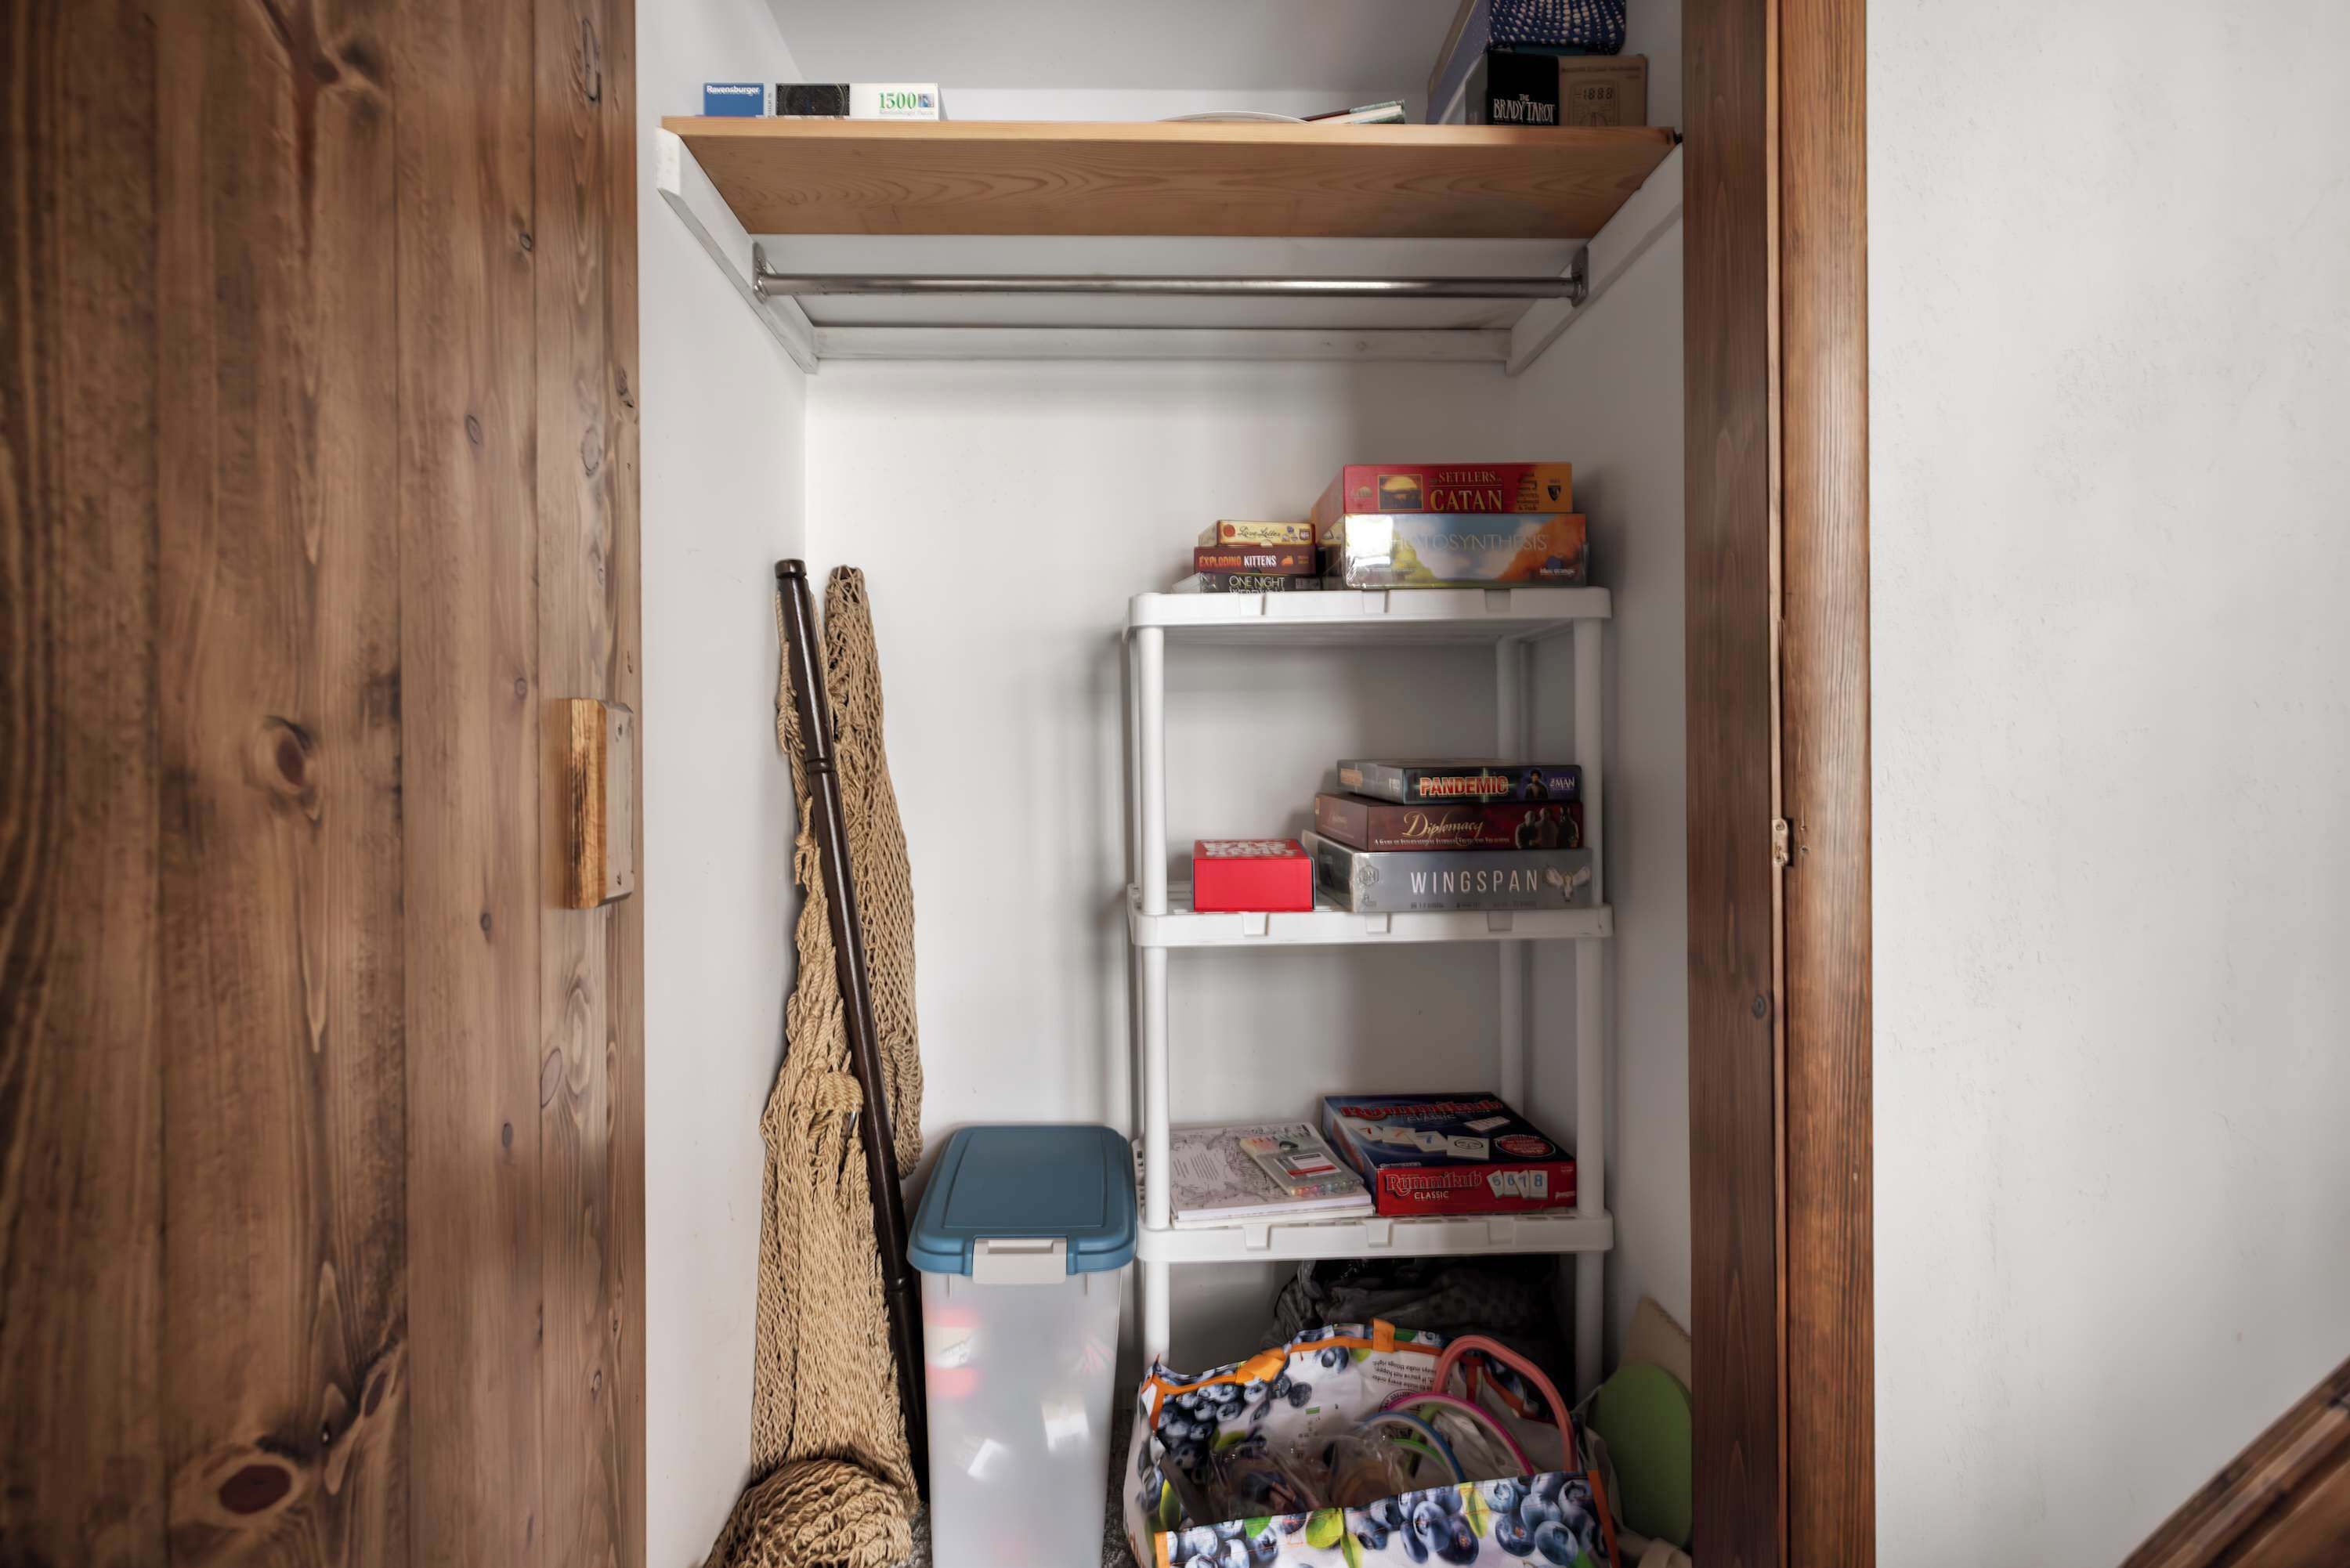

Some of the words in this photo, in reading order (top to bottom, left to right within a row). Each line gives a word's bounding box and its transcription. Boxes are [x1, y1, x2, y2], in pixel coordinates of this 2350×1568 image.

[707, 85, 760, 96] Ravensburger
[878, 92, 916, 110] 1500
[1494, 99, 1525, 121] BRADY
[1526, 102, 1556, 123] TAROT
[1439, 471, 1496, 483] SETTLERS
[1430, 489, 1503, 511] CATAN
[1238, 526, 1259, 537] Love
[1257, 527, 1281, 539] Letter
[1391, 533, 1548, 551] HOTOSYNTHESIS
[1199, 555, 1242, 567] EXPLODING
[1244, 555, 1277, 567] KITTENS
[1229, 575, 1253, 587] ONE
[1254, 576, 1285, 589] NIGHT
[1419, 776, 1509, 797] PANDEMIC
[1402, 811, 1484, 840] Diplomacy
[1411, 870, 1538, 894] WINGSPAN
[1340, 1099, 1503, 1121] Rummikub
[1407, 1112, 1456, 1122] CLASSIC
[1384, 1171, 1483, 1197] Rummikub
[1535, 1174, 1542, 1187] 8
[1414, 1191, 1449, 1201] CLASSIC
